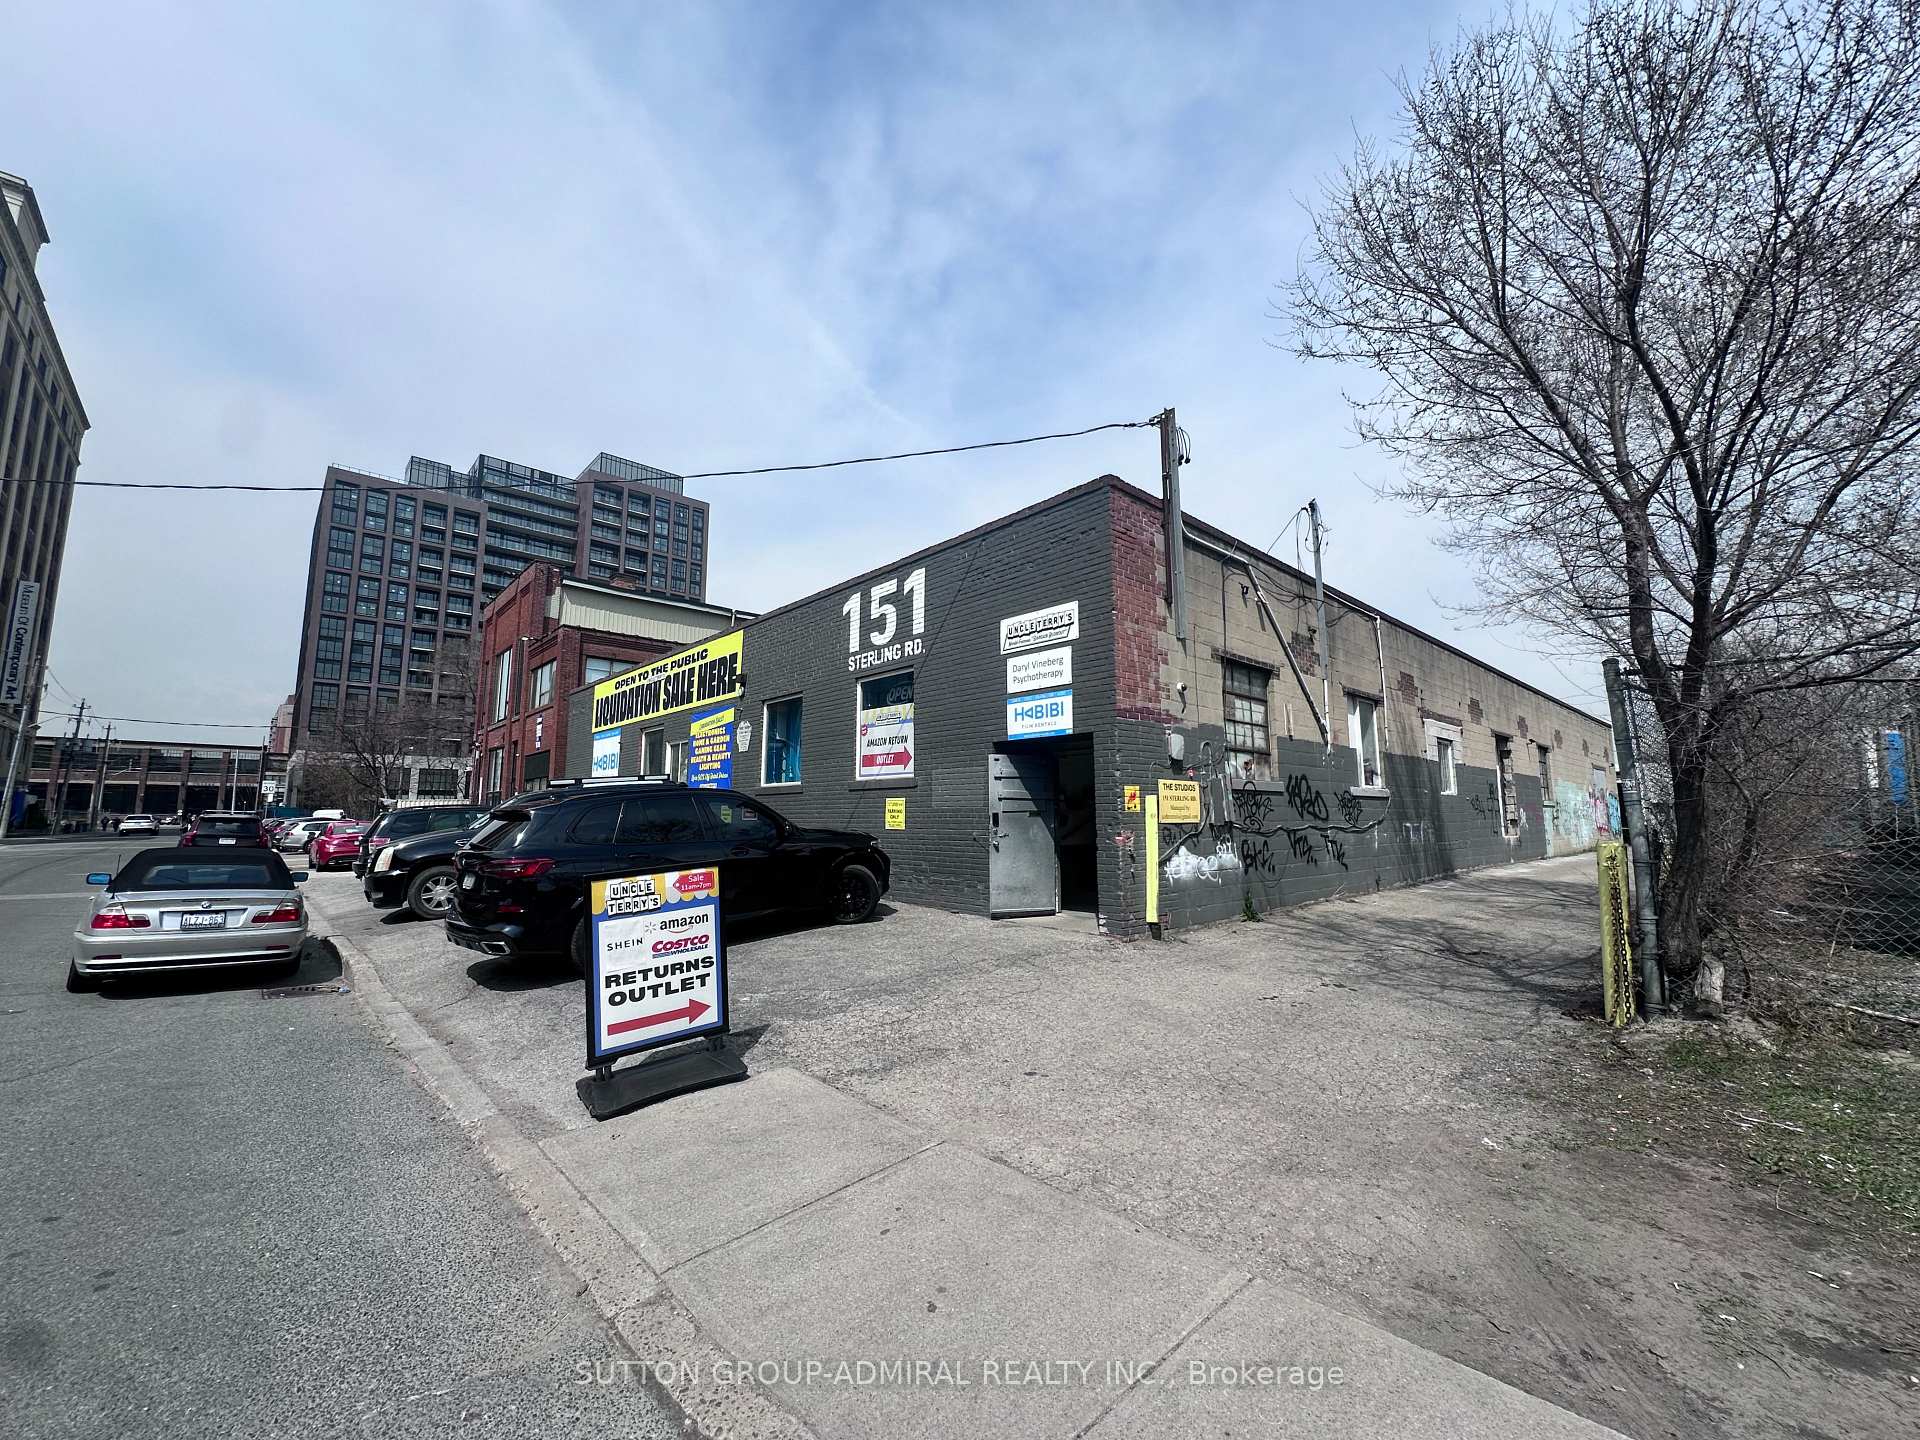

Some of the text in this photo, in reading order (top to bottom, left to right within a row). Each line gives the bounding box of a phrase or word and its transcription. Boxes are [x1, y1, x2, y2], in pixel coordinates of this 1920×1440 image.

[842, 567, 926, 653] 151
[1008, 612, 1073, 635] UNCLE TERRY'S
[6, 627, 28, 682] Contemporary
[848, 638, 926, 671] STERLING RD.
[614, 675, 636, 690] OPEN
[637, 670, 649, 682] TO
[650, 663, 669, 676] THE
[669, 648, 709, 670] PUBLIC
[1012, 657, 1064, 674] Daryl Vineberg
[1012, 669, 1064, 685] Psychotherapy
[5, 683, 18, 700] Art
[594, 652, 738, 728] LIQUIDATION SALE HERE
[866, 734, 909, 747] AMAZON RETURN
[876, 754, 895, 764] OUTLET
[1163, 783, 1196, 792] THE STUDIOS
[688, 874, 705, 883] Sale
[611, 882, 653, 897] UNCLE
[608, 898, 659, 914] TERRY'S
[660, 913, 709, 931] amazon
[607, 937, 643, 952] SHEIN
[651, 934, 710, 953] COSTCO
[670, 944, 708, 956] WHOLESALE
[605, 956, 715, 988] RETURNS
[608, 973, 711, 1007] OUTLET
